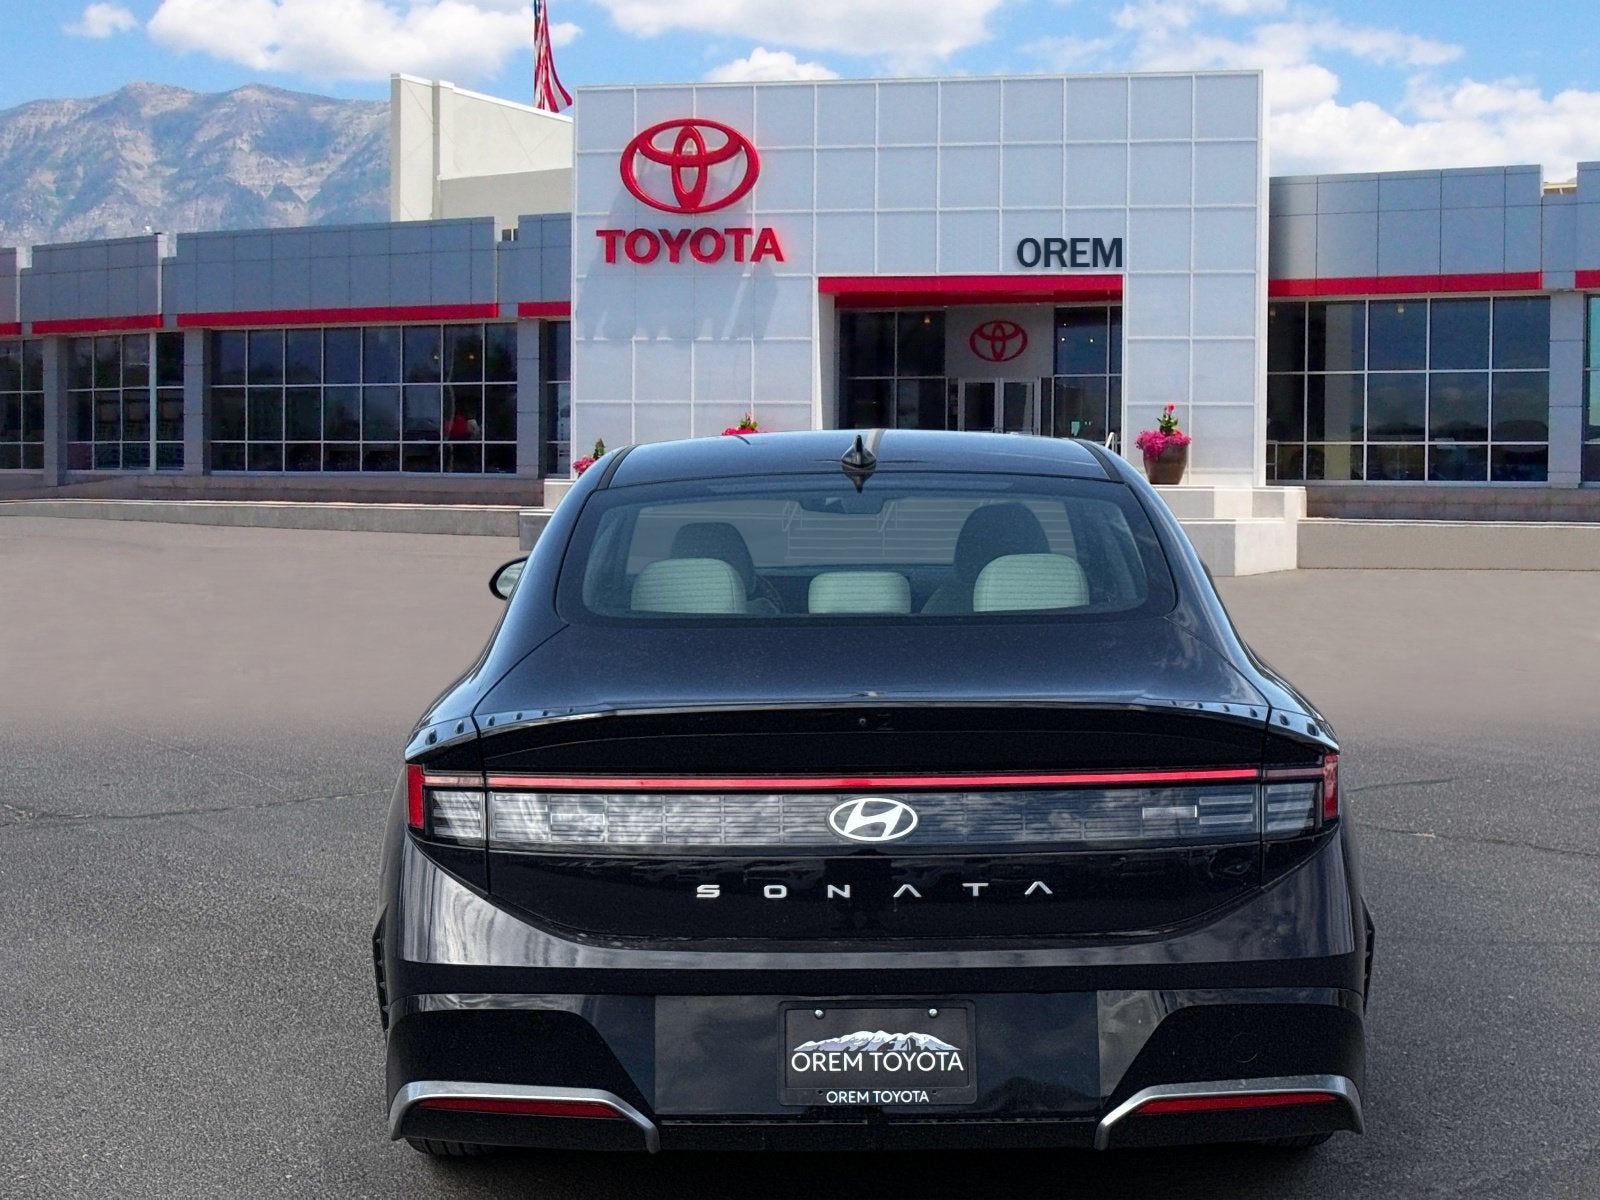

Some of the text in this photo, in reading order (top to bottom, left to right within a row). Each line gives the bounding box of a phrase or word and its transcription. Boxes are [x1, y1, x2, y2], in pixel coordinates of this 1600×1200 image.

[596, 227, 785, 264] TOYOTA
[1017, 237, 1122, 267] OREM
[696, 881, 1053, 899] SONATA
[791, 1052, 964, 1072] OREM TOYOTA
[826, 1090, 930, 1104] OREM TOYOTA
